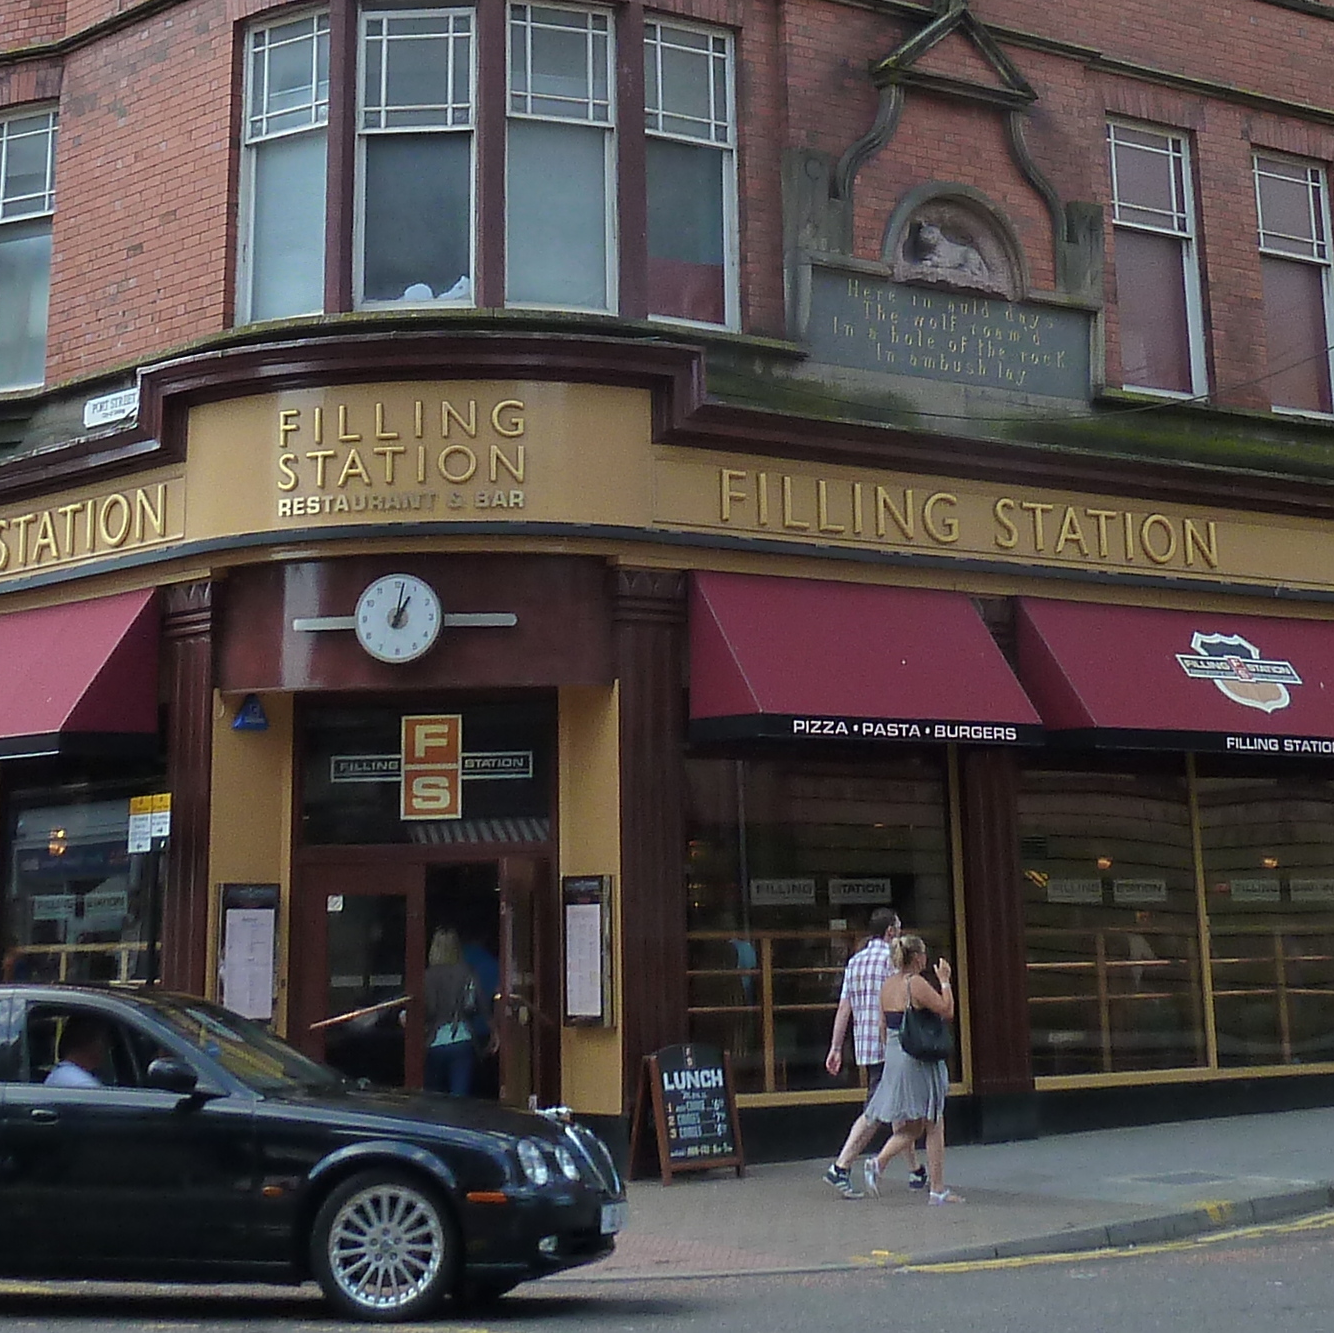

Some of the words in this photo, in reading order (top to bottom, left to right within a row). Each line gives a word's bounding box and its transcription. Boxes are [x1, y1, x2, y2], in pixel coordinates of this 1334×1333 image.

[848, 278, 895, 303] Here
[1006, 304, 1053, 329] days
[864, 300, 898, 324] The
[833, 316, 854, 337] In
[948, 336, 967, 354] of
[978, 338, 1006, 358] the
[877, 342, 895, 363] In
[909, 353, 986, 376] ambush
[998, 360, 1027, 386] lay
[110, 393, 136, 408] STREET
[279, 399, 525, 448] FILLING
[277, 444, 525, 492] STATION
[278, 493, 438, 517] RESTAURANT
[446, 492, 463, 509] &
[475, 489, 525, 509] BAR
[719, 468, 960, 544] FILLING
[994, 496, 1219, 568] STATION
[1184, 659, 1231, 671] FILLING
[1246, 663, 1292, 675] STATION
[415, 724, 449, 758] F
[793, 720, 849, 735] PIZZA
[862, 722, 921, 737] PASTA
[934, 724, 1017, 740] BURGERS
[1226, 736, 1279, 751] FILLING
[339, 761, 399, 772] FILLING
[464, 757, 524, 768] STATION
[412, 776, 451, 810] S
[663, 1069, 724, 1091] LUNCH
